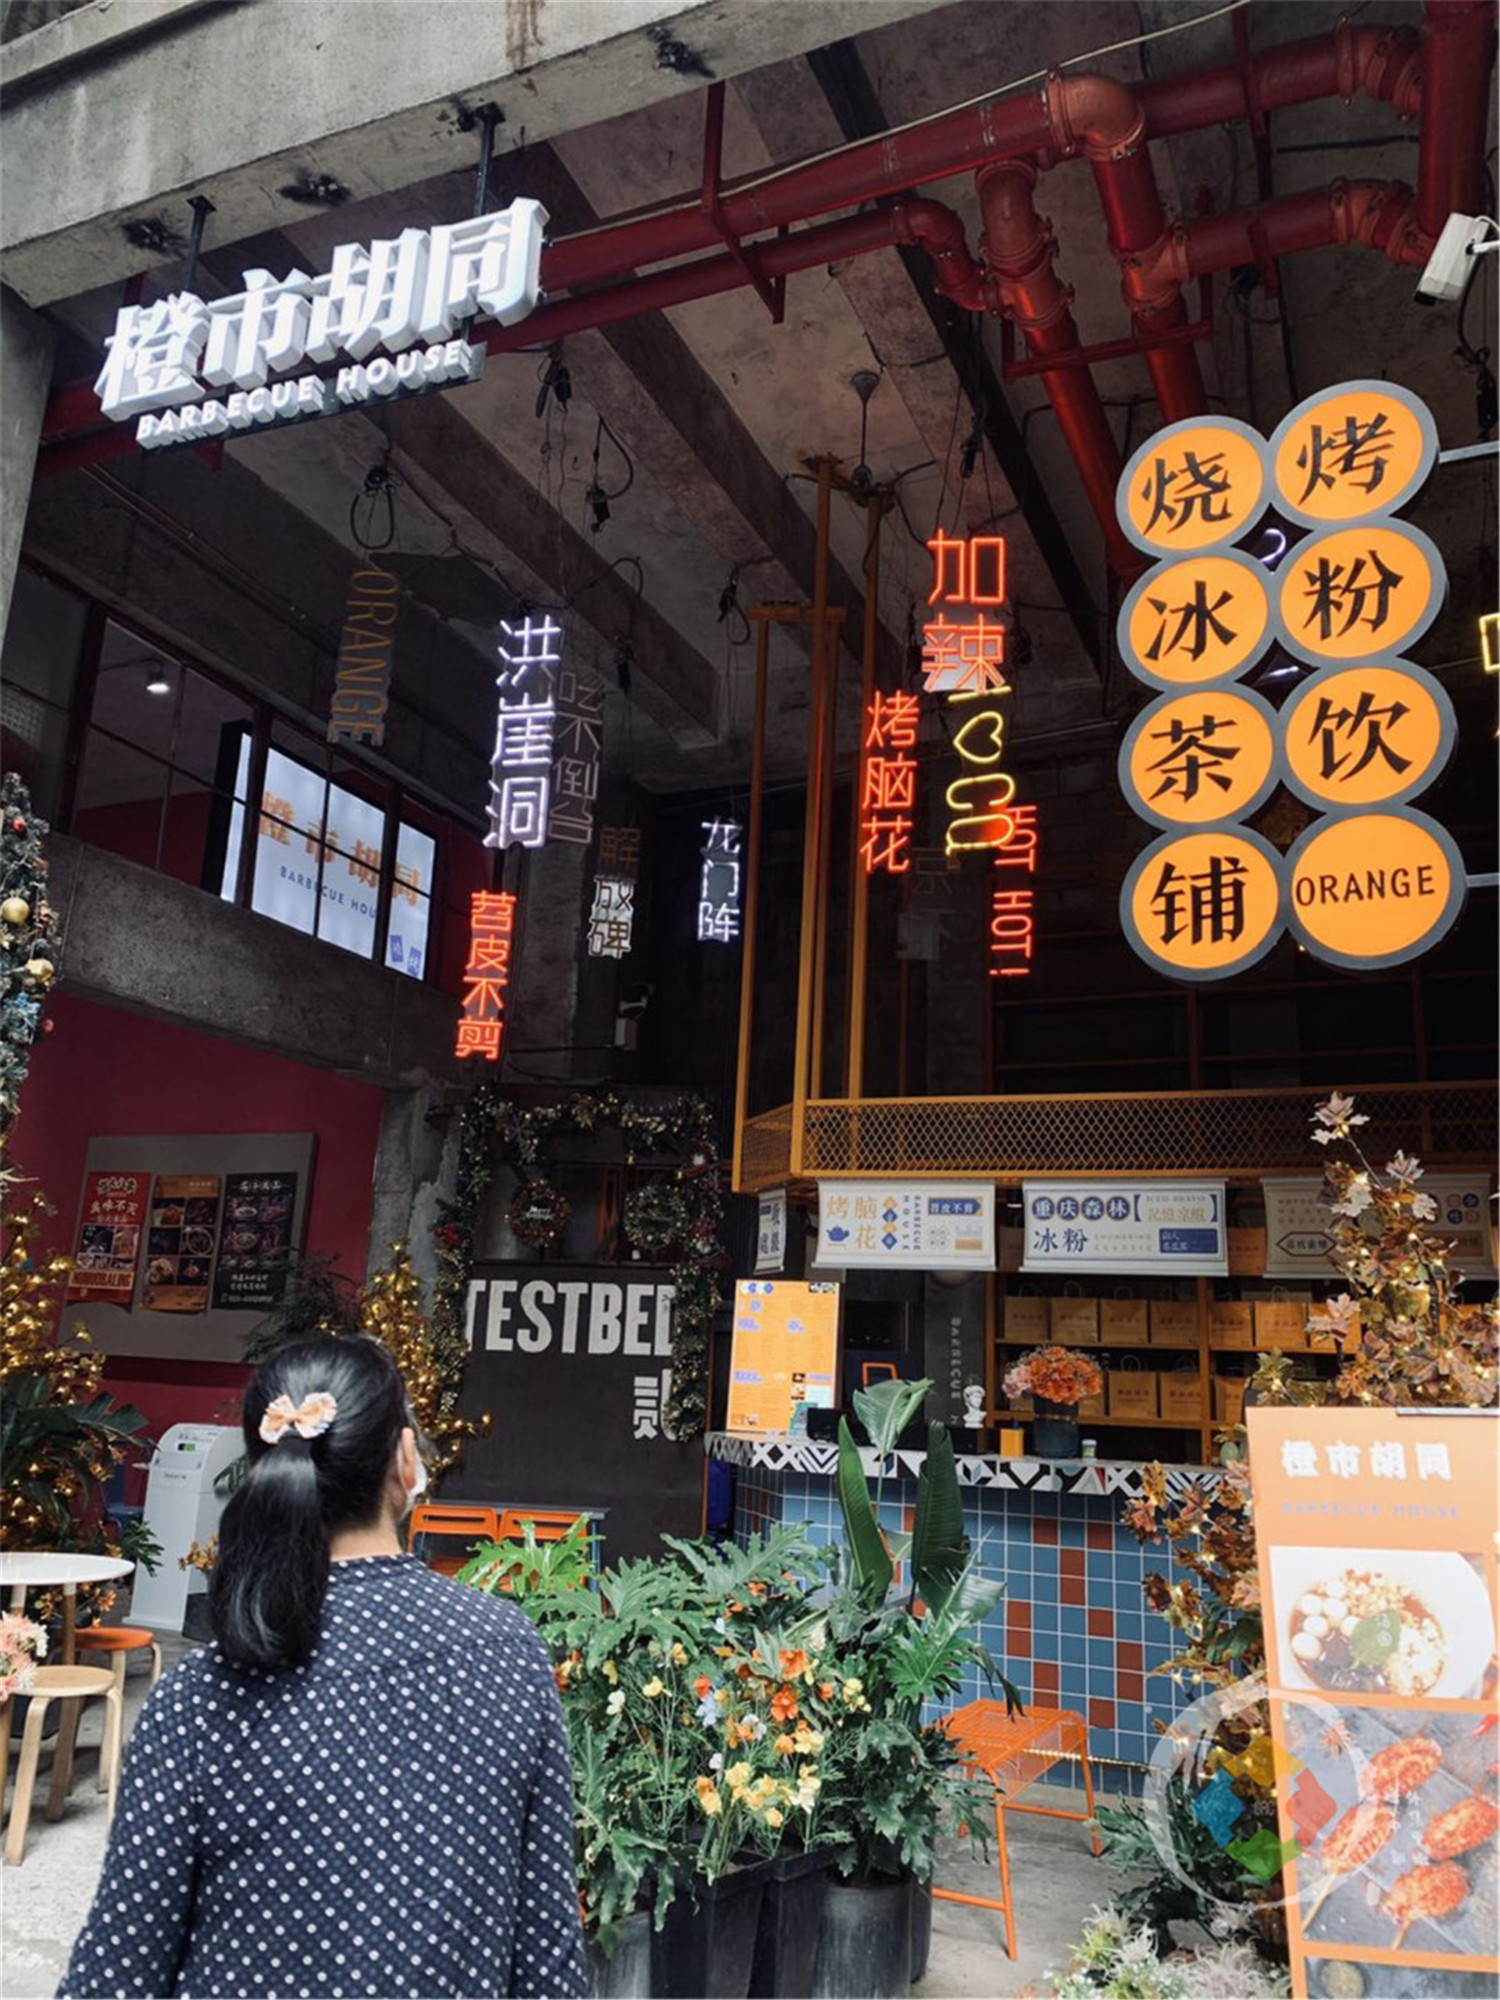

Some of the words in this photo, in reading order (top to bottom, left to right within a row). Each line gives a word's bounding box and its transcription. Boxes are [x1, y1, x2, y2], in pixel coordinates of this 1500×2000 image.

[94, 197, 550, 422] 橙市胡同
[135, 376, 326, 450] BARBECUE
[336, 339, 472, 404] HOUSE
[326, 570, 399, 747] ORANGE
[920, 527, 1006, 694] 加辣
[483, 614, 561, 850] 洪崖洞
[858, 689, 921, 874] 烤脑花
[279, 865, 345, 905] BARBCUE
[698, 816, 743, 943] 龙门阵
[1150, 856, 1250, 947] 铺
[1295, 866, 1436, 906] ORANGE
[455, 889, 517, 1061] 苕皮不剪
[1033, 1198, 1129, 1220] 重庆森林
[1033, 1227, 1089, 1254] 冰粉
